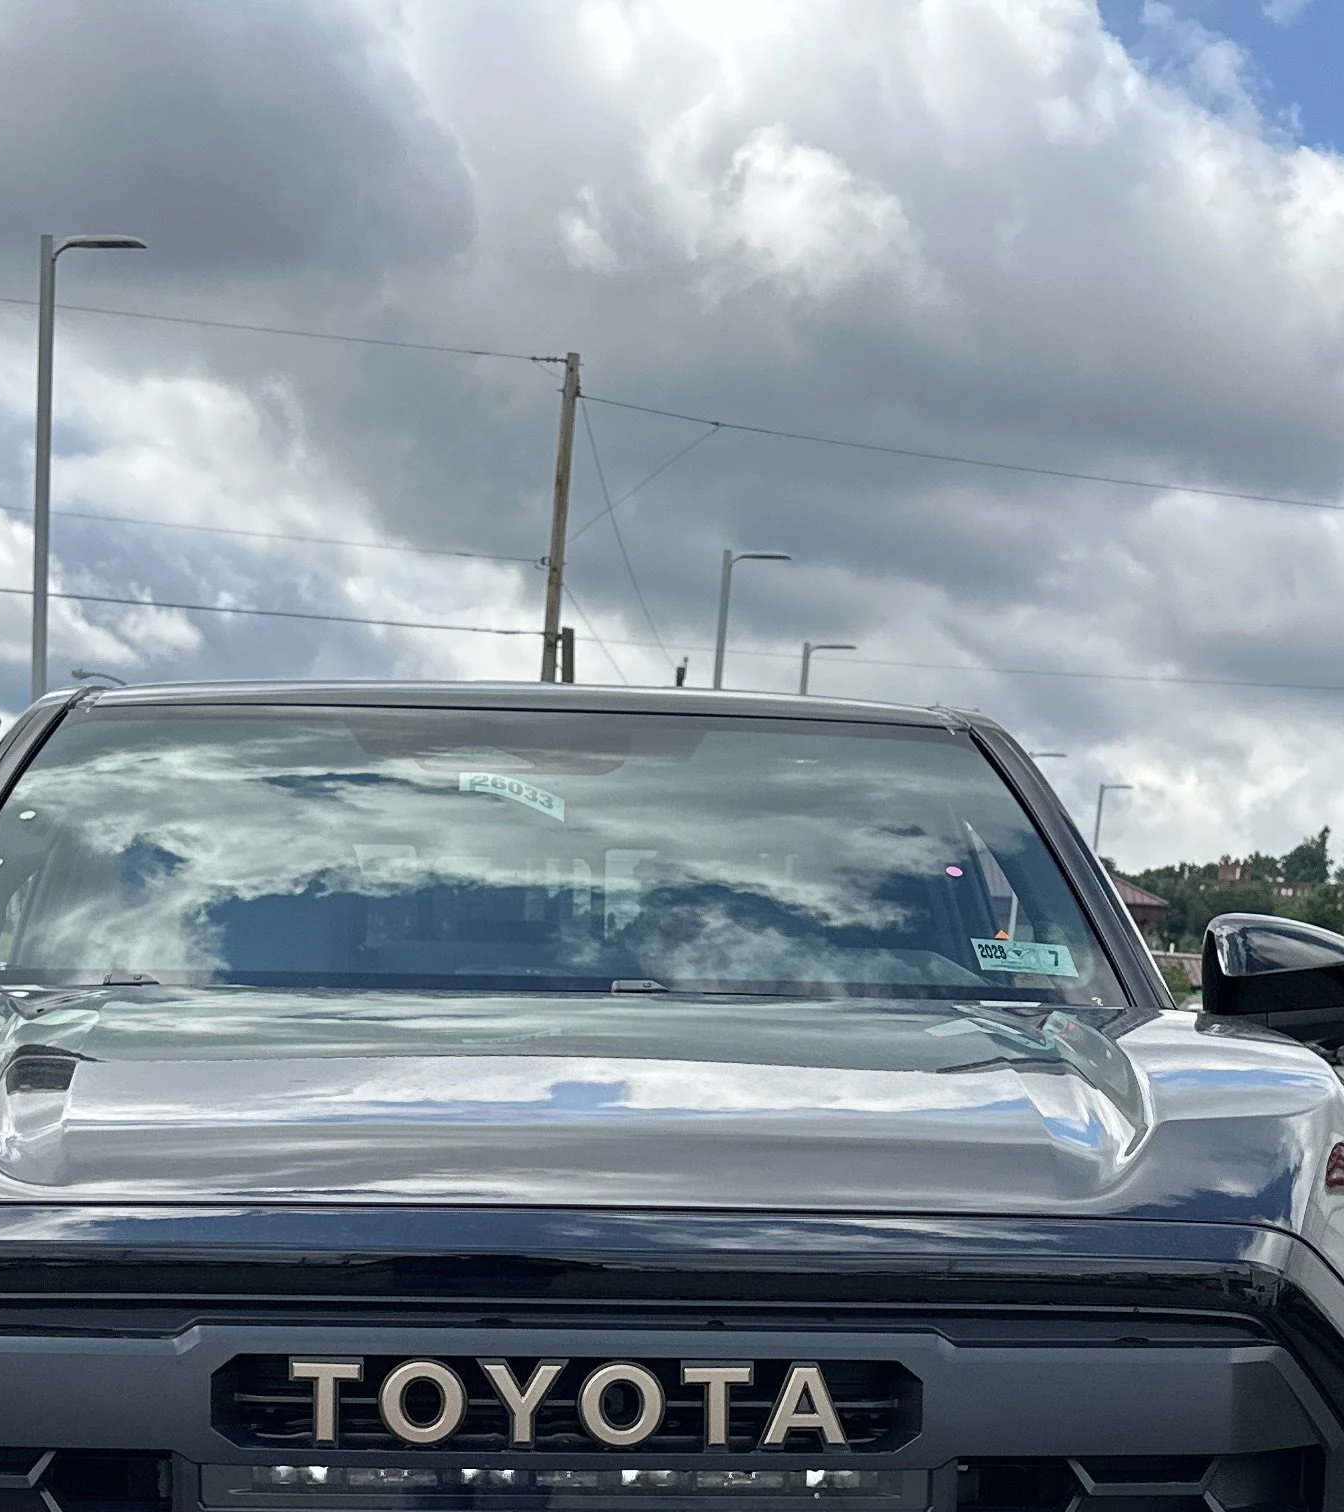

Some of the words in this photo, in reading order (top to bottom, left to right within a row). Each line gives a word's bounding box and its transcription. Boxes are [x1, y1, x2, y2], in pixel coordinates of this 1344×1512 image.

[472, 775, 554, 809] 26033
[1048, 949, 1059, 966] 7
[289, 1357, 850, 1450] TOYOTA
